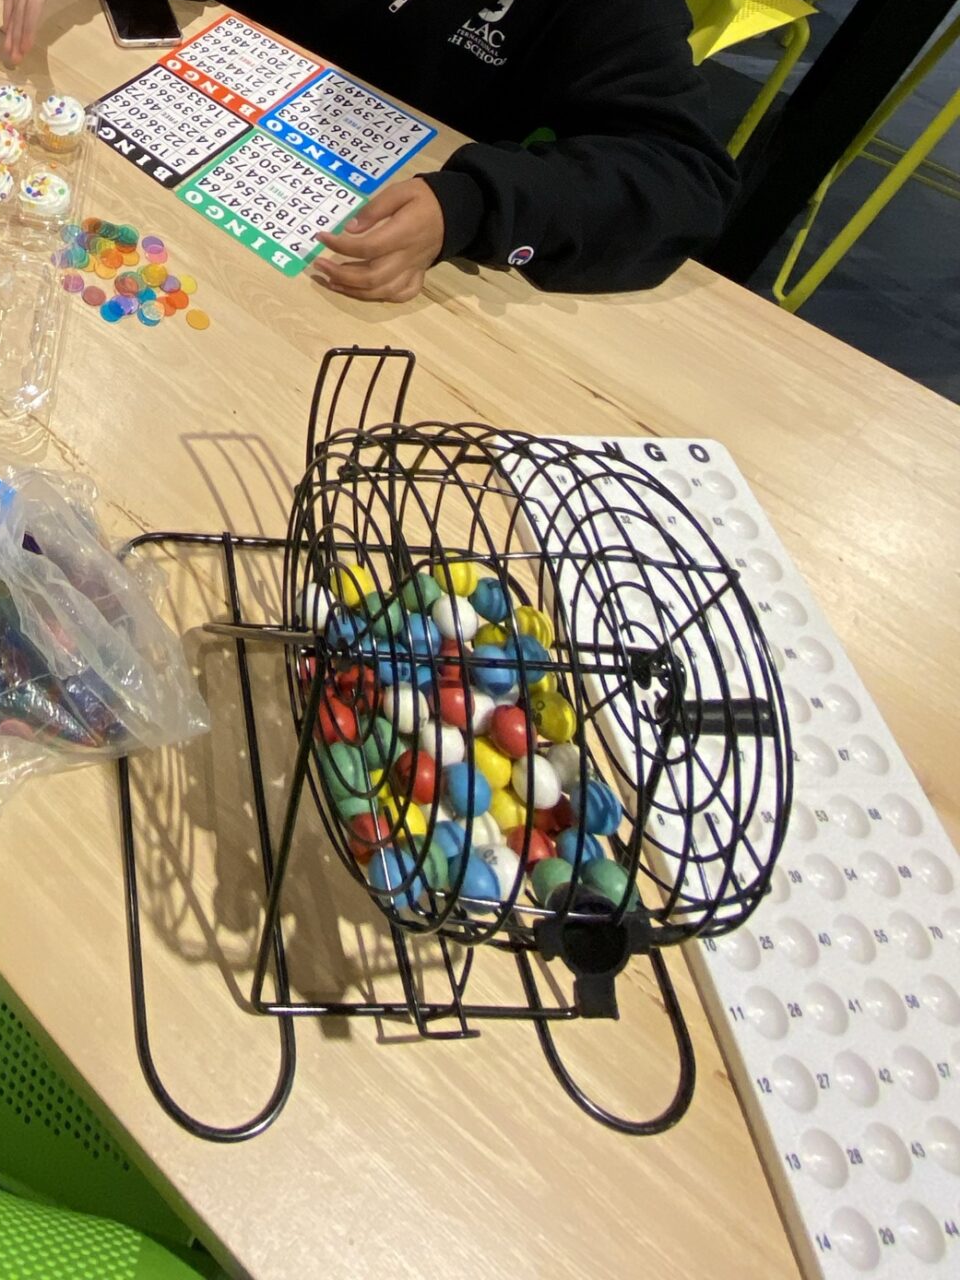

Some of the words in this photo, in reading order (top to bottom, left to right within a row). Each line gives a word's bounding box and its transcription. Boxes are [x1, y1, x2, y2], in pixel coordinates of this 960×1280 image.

[214, 25, 233, 37] 63
[462, 19, 505, 48] LAC
[231, 35, 250, 47] 48
[249, 47, 268, 59] 31
[266, 57, 287, 70] 20
[153, 69, 172, 81] 61
[288, 71, 301, 79] 7
[327, 74, 345, 88] 71
[166, 60, 257, 116] BINGO
[168, 79, 189, 94] 52
[344, 86, 365, 98] 49
[186, 91, 207, 106] 33
[364, 97, 385, 110] 43
[205, 103, 223, 118] 16
[278, 108, 299, 122] 63
[383, 111, 407, 124] 27
[227, 118, 241, 128] 2
[297, 121, 319, 136] 50
[410, 123, 422, 132] 4
[251, 135, 273, 151] 73
[318, 134, 340, 149] 33
[266, 119, 367, 187] BINGO
[271, 147, 294, 163] 52
[338, 147, 358, 162] 18
[291, 161, 314, 175] 44
[359, 160, 380, 176] 13
[198, 177, 221, 192] 64
[313, 176, 337, 191] 29
[217, 193, 241, 207] 47
[335, 188, 356, 205] 10
[240, 207, 264, 224] 39
[186, 190, 292, 269] BINGO
[263, 221, 287, 239] 26
[289, 241, 302, 252] 9
[703, 939, 717, 952] 10
[759, 936, 774, 950] 25
[819, 933, 832, 946] 40
[874, 930, 889, 943] 55
[930, 926, 943, 939] 70
[730, 1006, 745, 1021] 11
[848, 999, 862, 1014] 41
[757, 1077, 772, 1094] 12
[817, 1073, 830, 1089] 27
[878, 1068, 893, 1084] 42
[937, 1063, 951, 1078] 57
[785, 1153, 801, 1169] 13
[847, 1148, 864, 1165] 28
[911, 1142, 926, 1158] 43
[816, 1233, 831, 1251] 14
[879, 1228, 895, 1245] 29
[944, 1221, 959, 1237] 44
